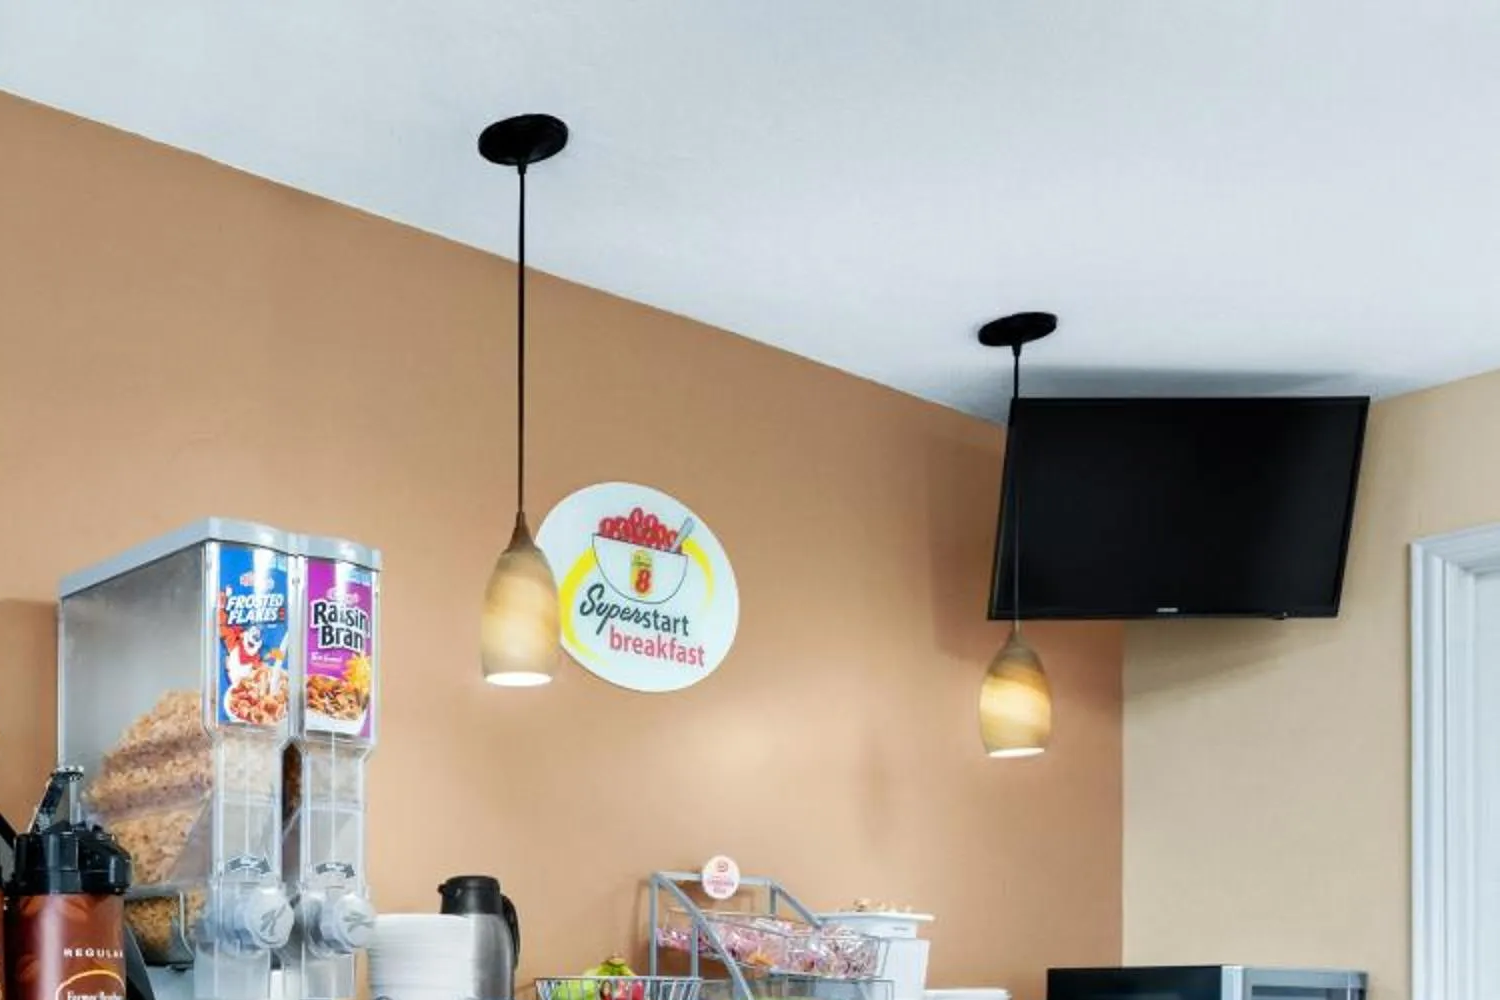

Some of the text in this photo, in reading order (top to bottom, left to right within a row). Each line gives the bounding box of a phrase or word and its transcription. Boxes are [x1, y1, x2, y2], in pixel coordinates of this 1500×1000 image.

[227, 607, 279, 625] FLAKES
[313, 601, 368, 632] Raisin
[579, 583, 689, 636] Superstart
[321, 625, 364, 649] Bran
[610, 625, 706, 668] breakfast
